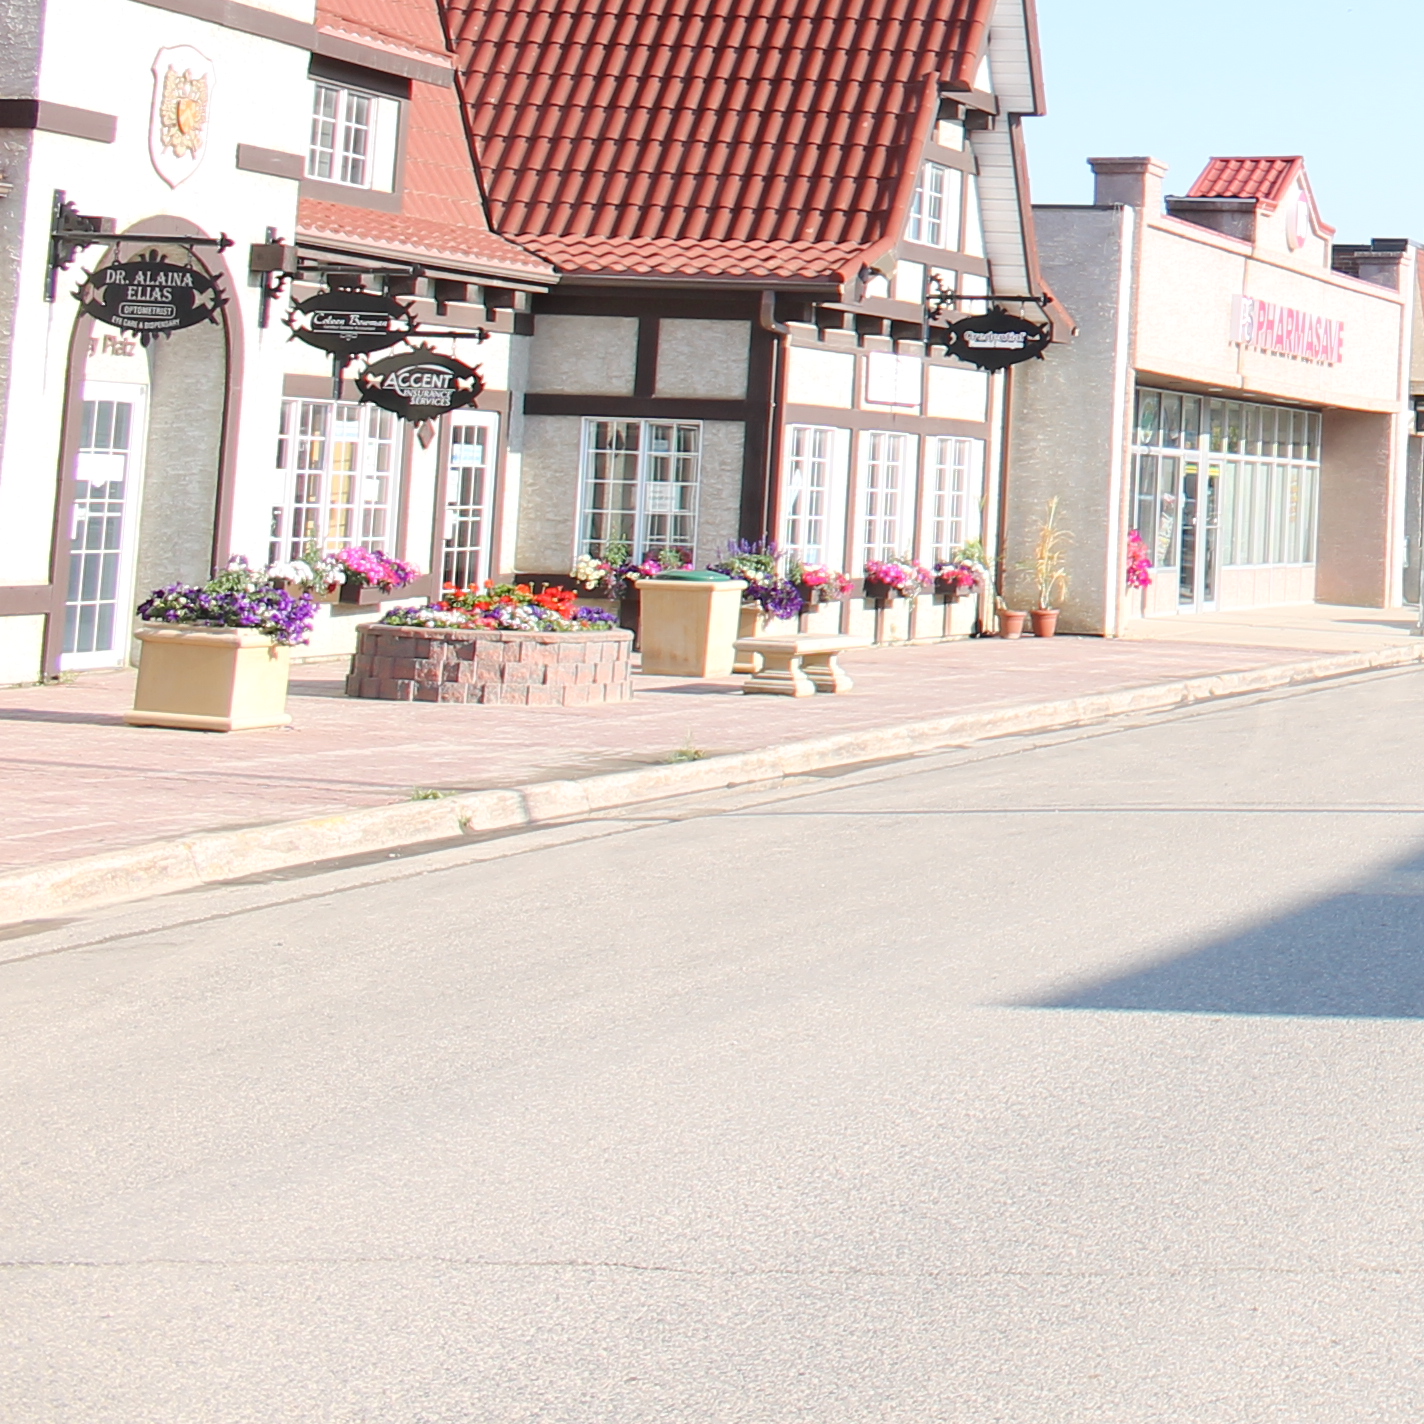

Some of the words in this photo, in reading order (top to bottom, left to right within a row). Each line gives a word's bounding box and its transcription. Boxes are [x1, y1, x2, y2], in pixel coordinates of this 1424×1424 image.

[105, 269, 130, 285] DR.
[133, 270, 194, 287] ALAINA
[127, 286, 172, 302] ELIAS
[123, 305, 172, 316] OPTOMETRIST
[111, 315, 123, 326] EYE
[123, 318, 138, 329] CARE
[1256, 299, 1344, 364] PHARMASAVE
[382, 372, 454, 389] ACCENT
[403, 389, 453, 398] INSURANCE
[409, 396, 451, 407] SERVICES
